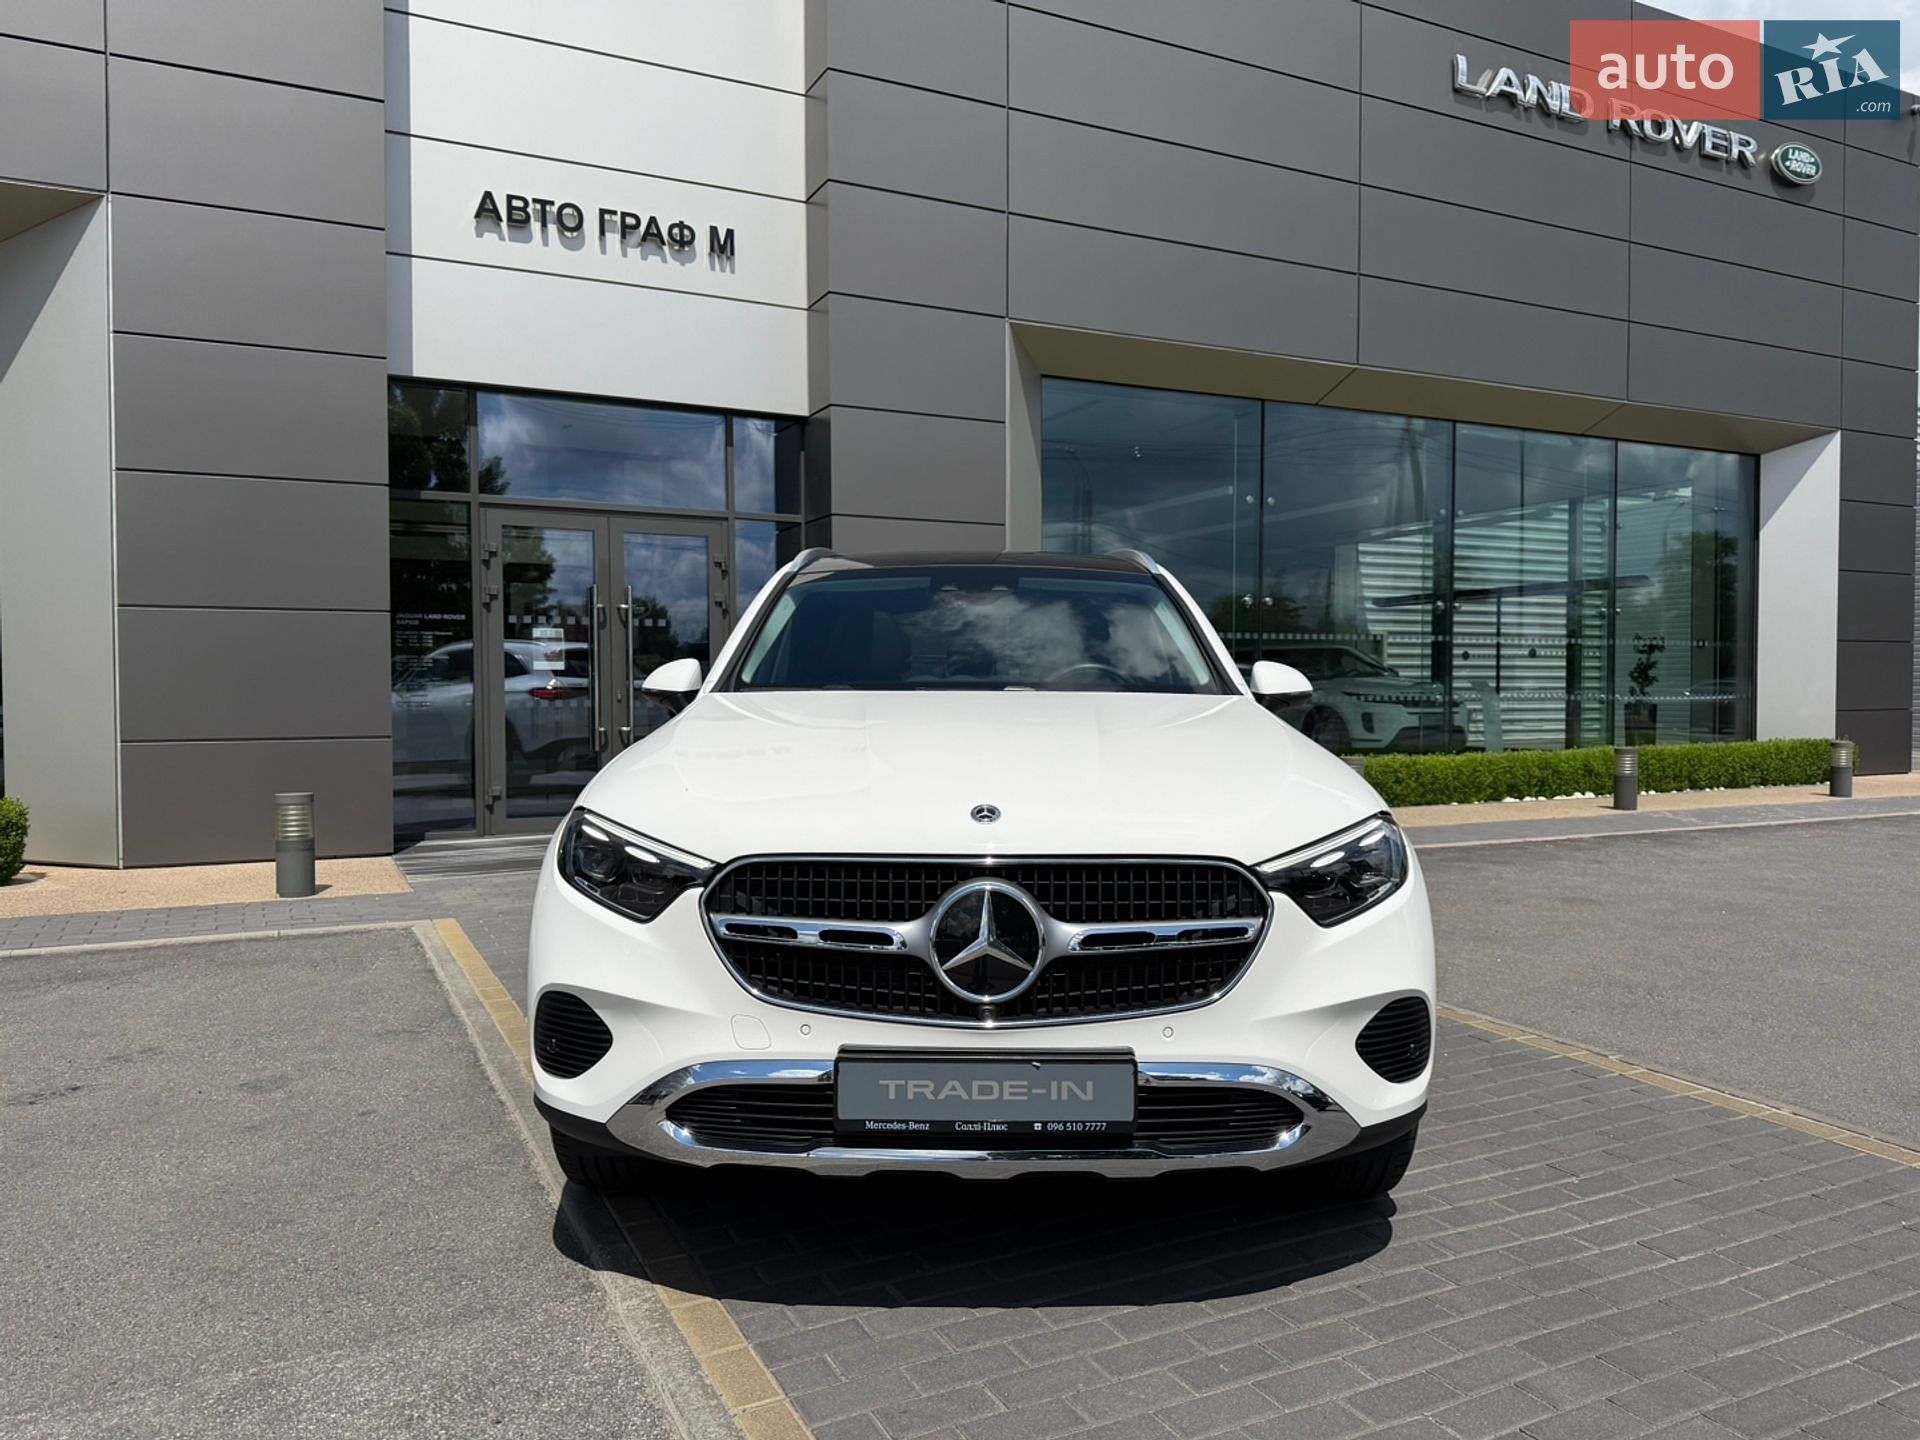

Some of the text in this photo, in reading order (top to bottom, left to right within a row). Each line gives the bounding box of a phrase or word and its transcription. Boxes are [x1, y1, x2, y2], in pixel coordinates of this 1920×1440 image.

[1453, 52, 1759, 168] LAND ROVER
[1788, 148, 1811, 163] LAND
[1789, 160, 1816, 176] ROVER
[473, 190, 736, 257] АВТО ГРАФ М
[879, 1080, 1094, 1101] TRADE-IN
[865, 1120, 930, 1131] Mercedes-Benz
[1046, 1122, 1107, 1131] 096 510 7777
